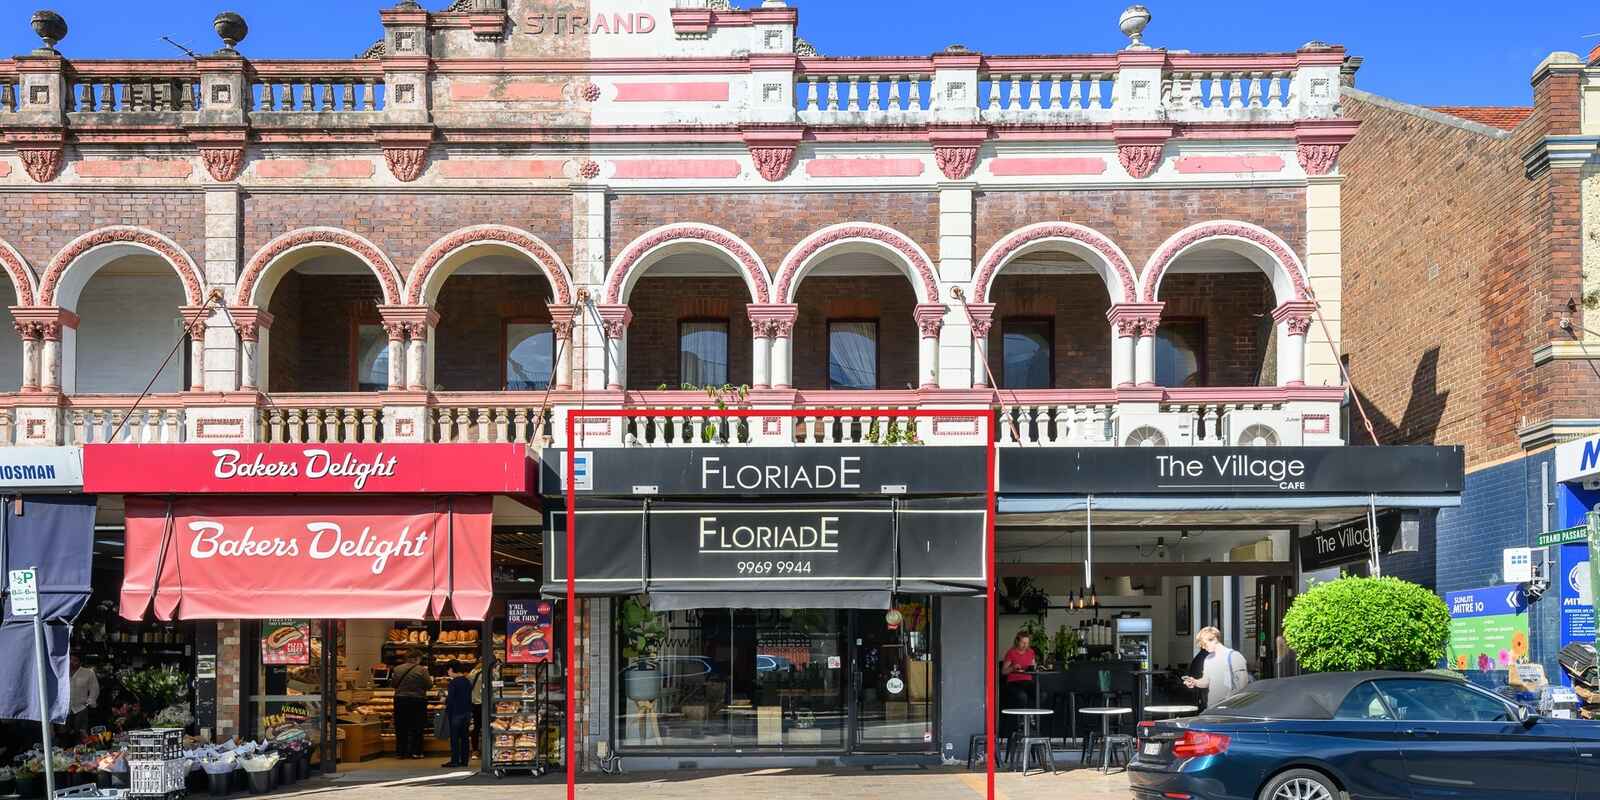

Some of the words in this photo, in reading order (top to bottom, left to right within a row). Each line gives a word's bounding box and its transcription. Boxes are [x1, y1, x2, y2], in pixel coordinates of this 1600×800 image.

[524, 12, 656, 35] STRAND
[0, 464, 56, 480] OSMAN
[212, 448, 299, 478] Bakers
[303, 448, 398, 490] Delight
[702, 456, 861, 489] FLORIADE
[1155, 454, 1204, 477] The
[1212, 454, 1305, 482] Village
[1279, 481, 1305, 490] CAFE
[699, 516, 840, 549] FLORIADE
[1539, 533, 1560, 546] STRAND
[1562, 527, 1588, 542] PASSAGE
[188, 520, 300, 559] Bakers
[306, 521, 429, 575] Delight
[1316, 535, 1336, 554] The
[737, 560, 773, 574] 9969
[776, 560, 812, 574] 9944
[1453, 602, 1474, 614] MITRE
[1475, 601, 1484, 612] 10
